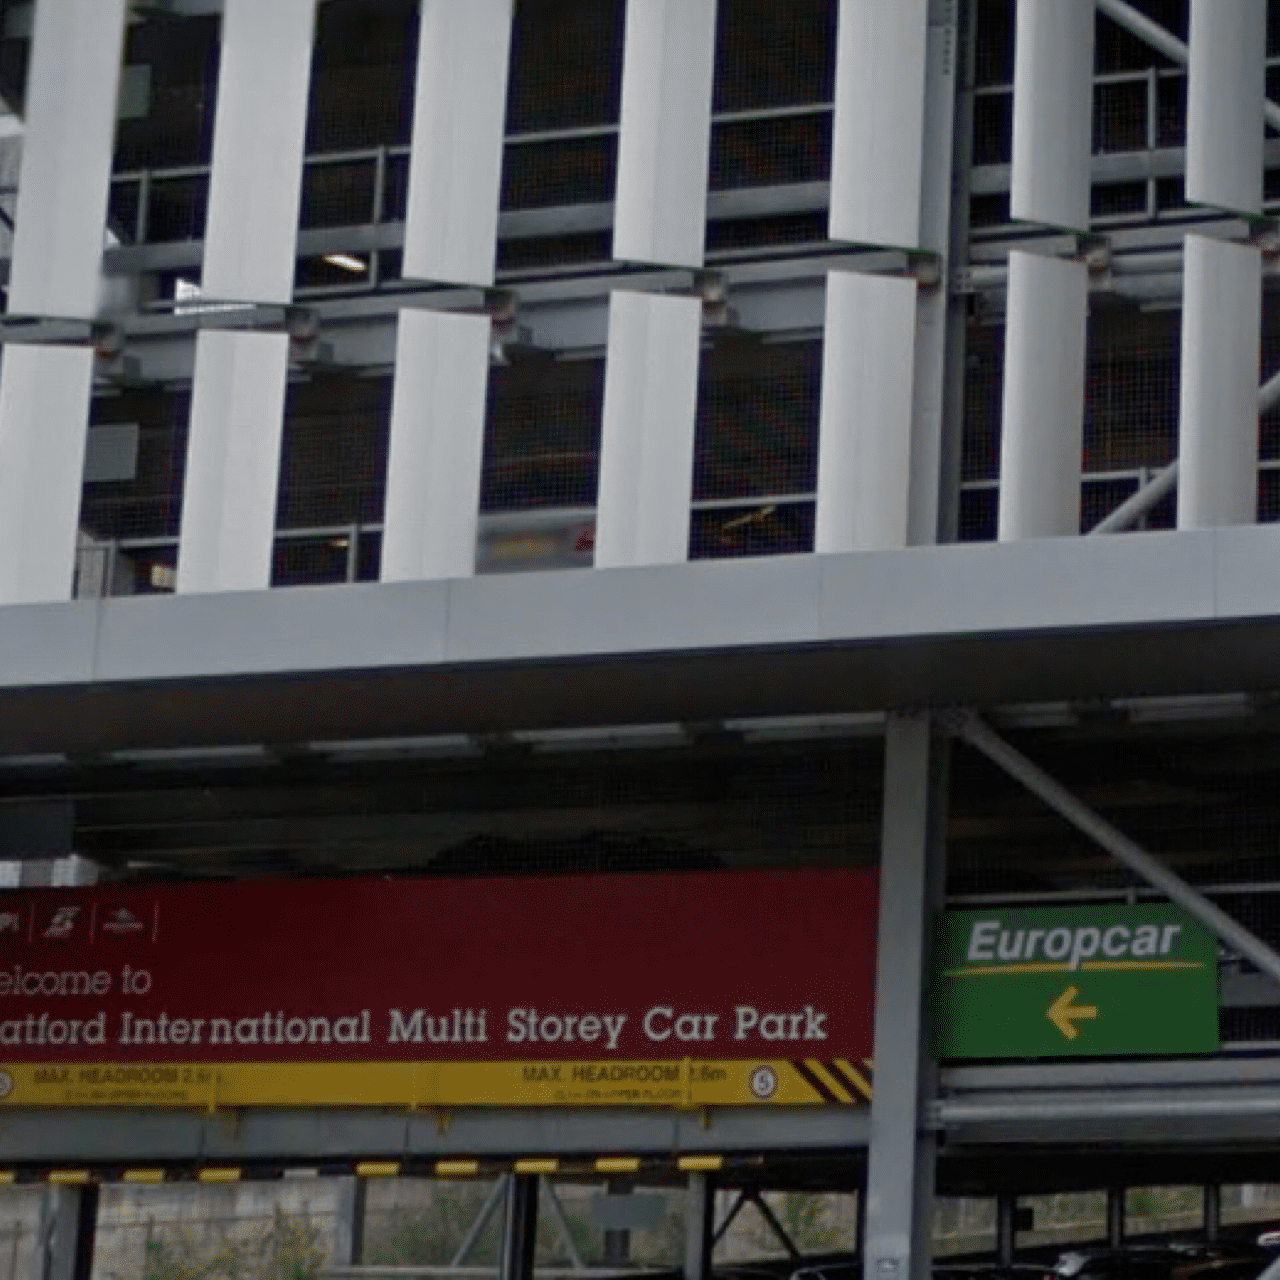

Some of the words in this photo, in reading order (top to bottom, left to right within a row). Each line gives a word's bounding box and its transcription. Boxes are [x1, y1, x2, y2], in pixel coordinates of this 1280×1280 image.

[967, 919, 1183, 971] Europcar
[121, 963, 153, 995] to
[120, 1007, 371, 1045] International
[388, 1007, 488, 1043] Multi
[506, 1006, 628, 1050] Storey
[643, 1005, 720, 1041] Car
[733, 1004, 828, 1041] Park
[79, 1067, 179, 1083] HEADROOM
[571, 1064, 681, 1082] HEADROOM
[757, 1073, 771, 1092] 5
